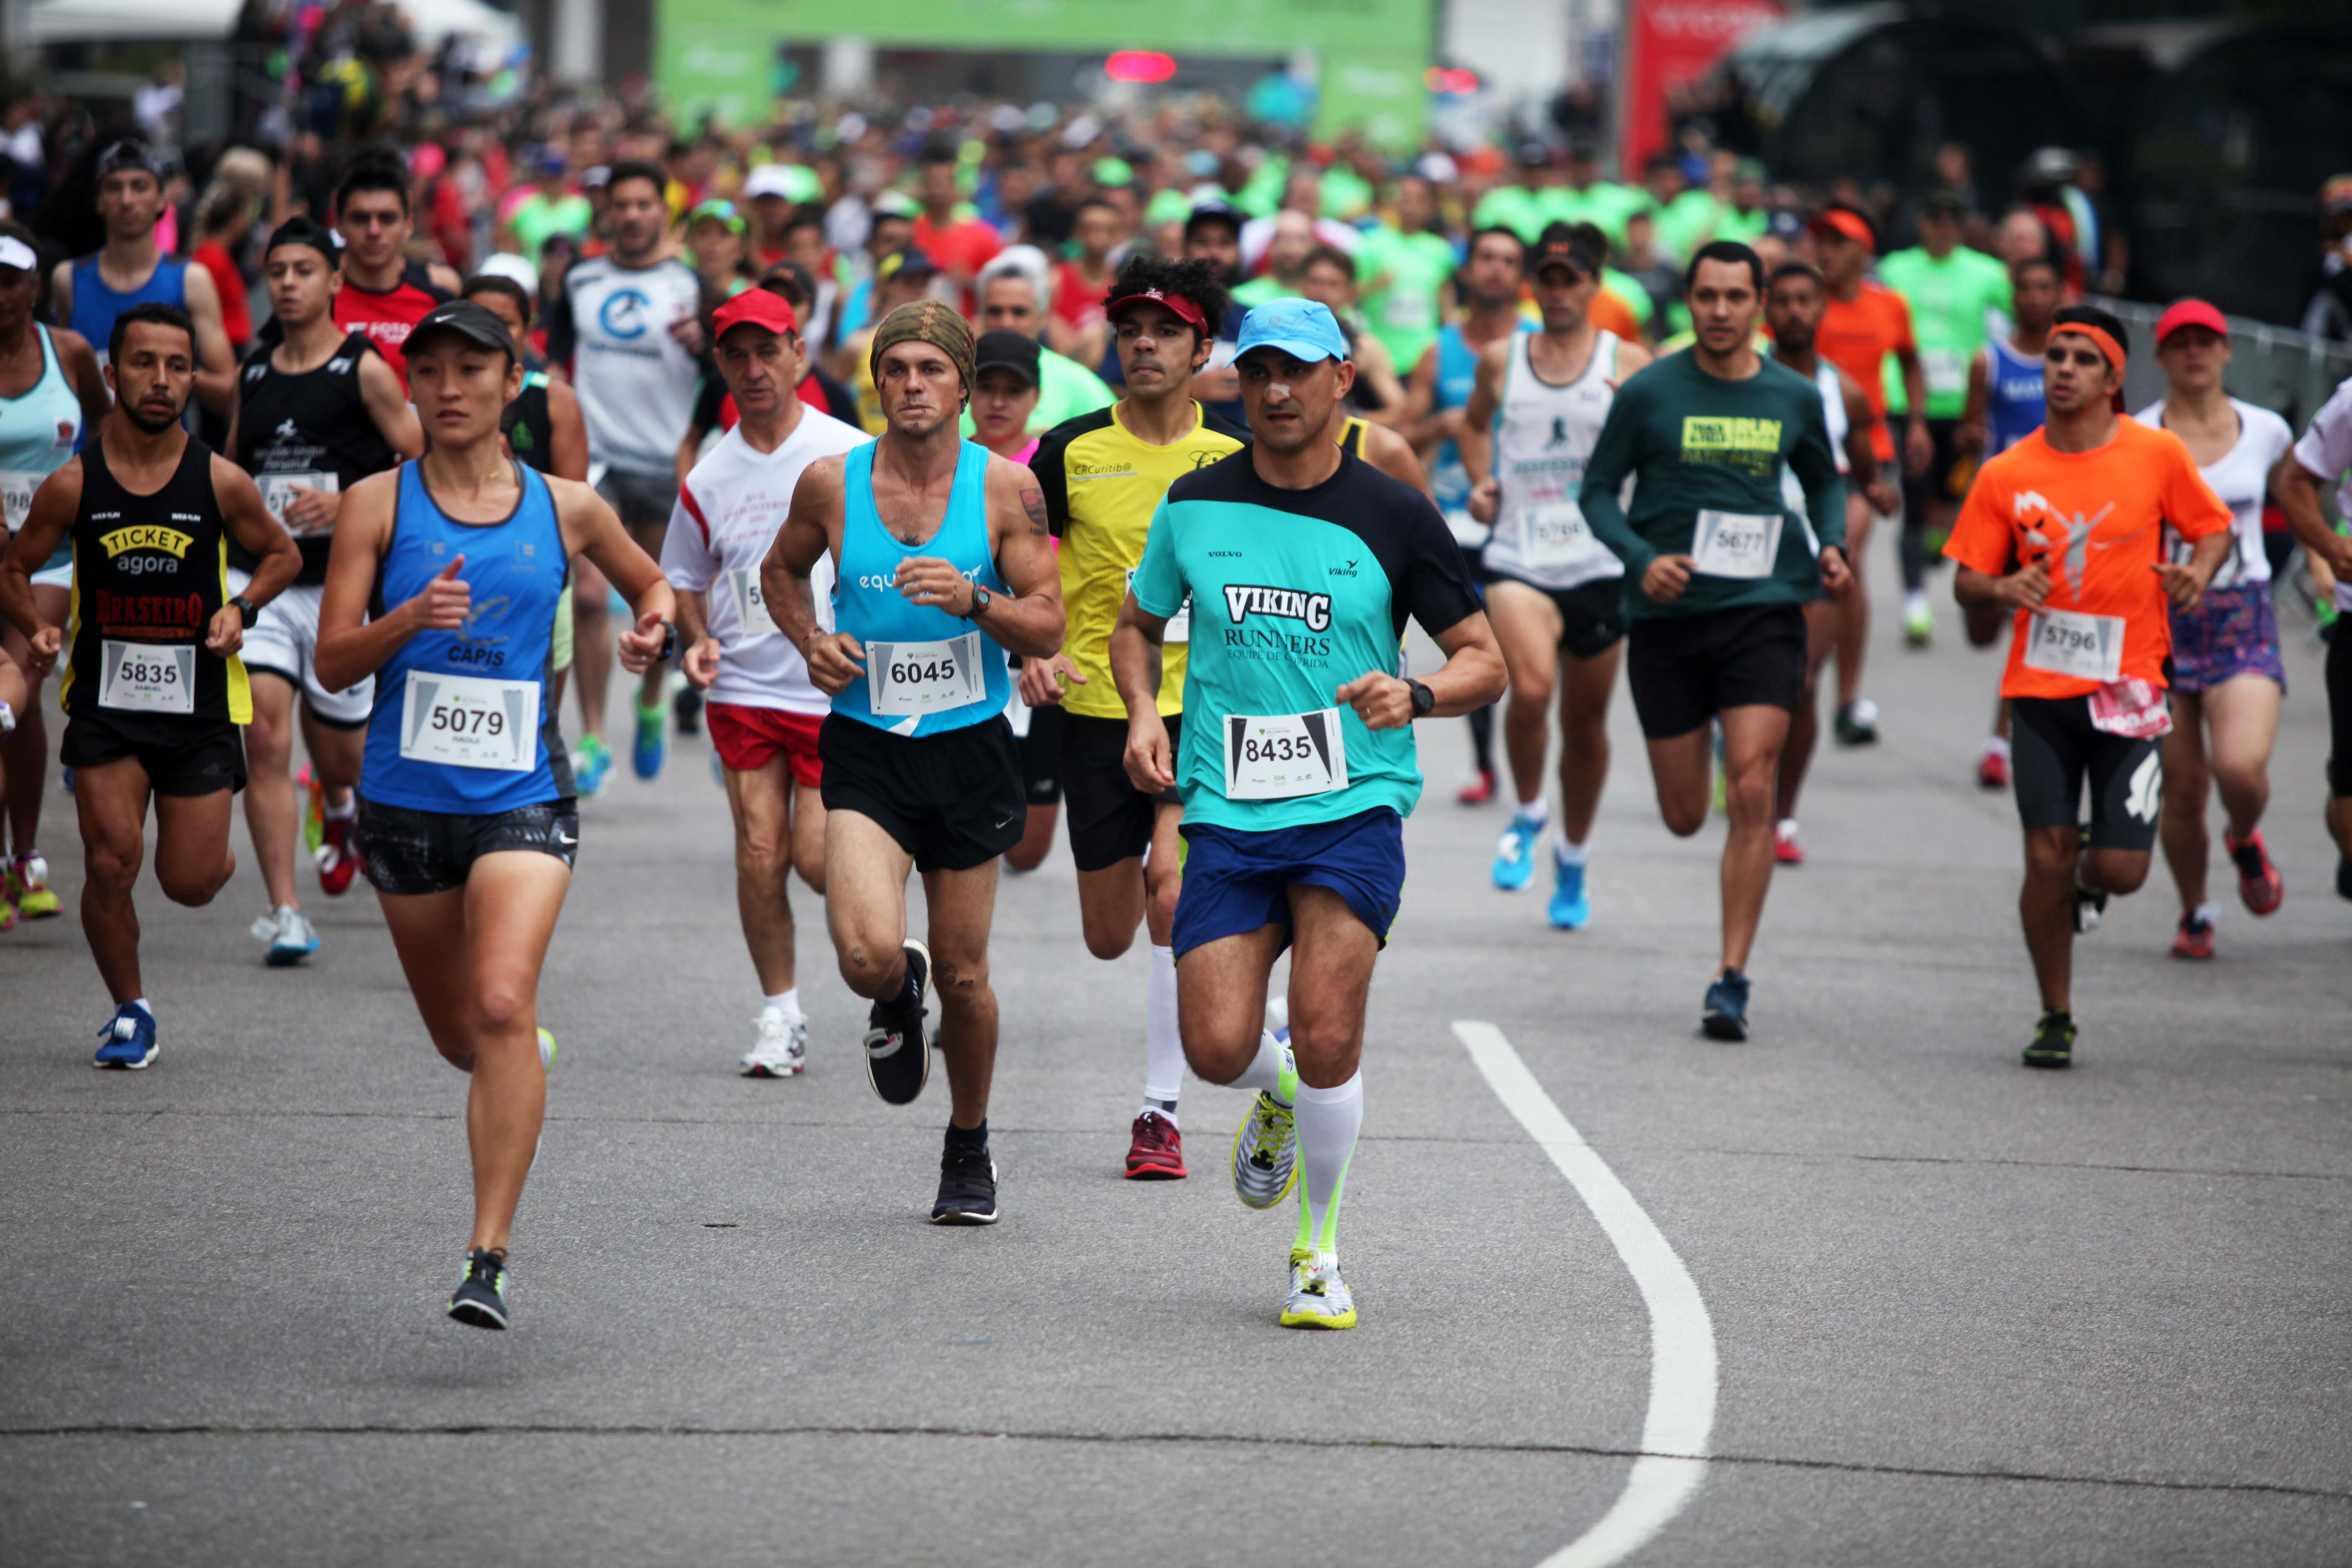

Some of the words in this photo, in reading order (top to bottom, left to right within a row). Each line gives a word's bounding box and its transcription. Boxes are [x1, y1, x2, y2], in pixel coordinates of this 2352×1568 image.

[1075, 462, 1132, 475] CRCuritib@
[108, 529, 184, 551] TICKET
[117, 555, 178, 575] agora
[1328, 567, 1358, 578] Viking
[95, 589, 203, 628] BRASEIRO
[1223, 584, 1332, 633] VIKING
[1225, 629, 1331, 656] RUNNERS
[2045, 627, 2095, 651] 5796
[448, 646, 505, 667] CAPIS
[1227, 650, 1264, 660] EQUIPE
[1266, 652, 1281, 661] DE
[121, 661, 177, 684] 5835
[891, 658, 955, 684] 6045
[432, 706, 503, 735] 5079
[1246, 735, 1311, 762] 8435
